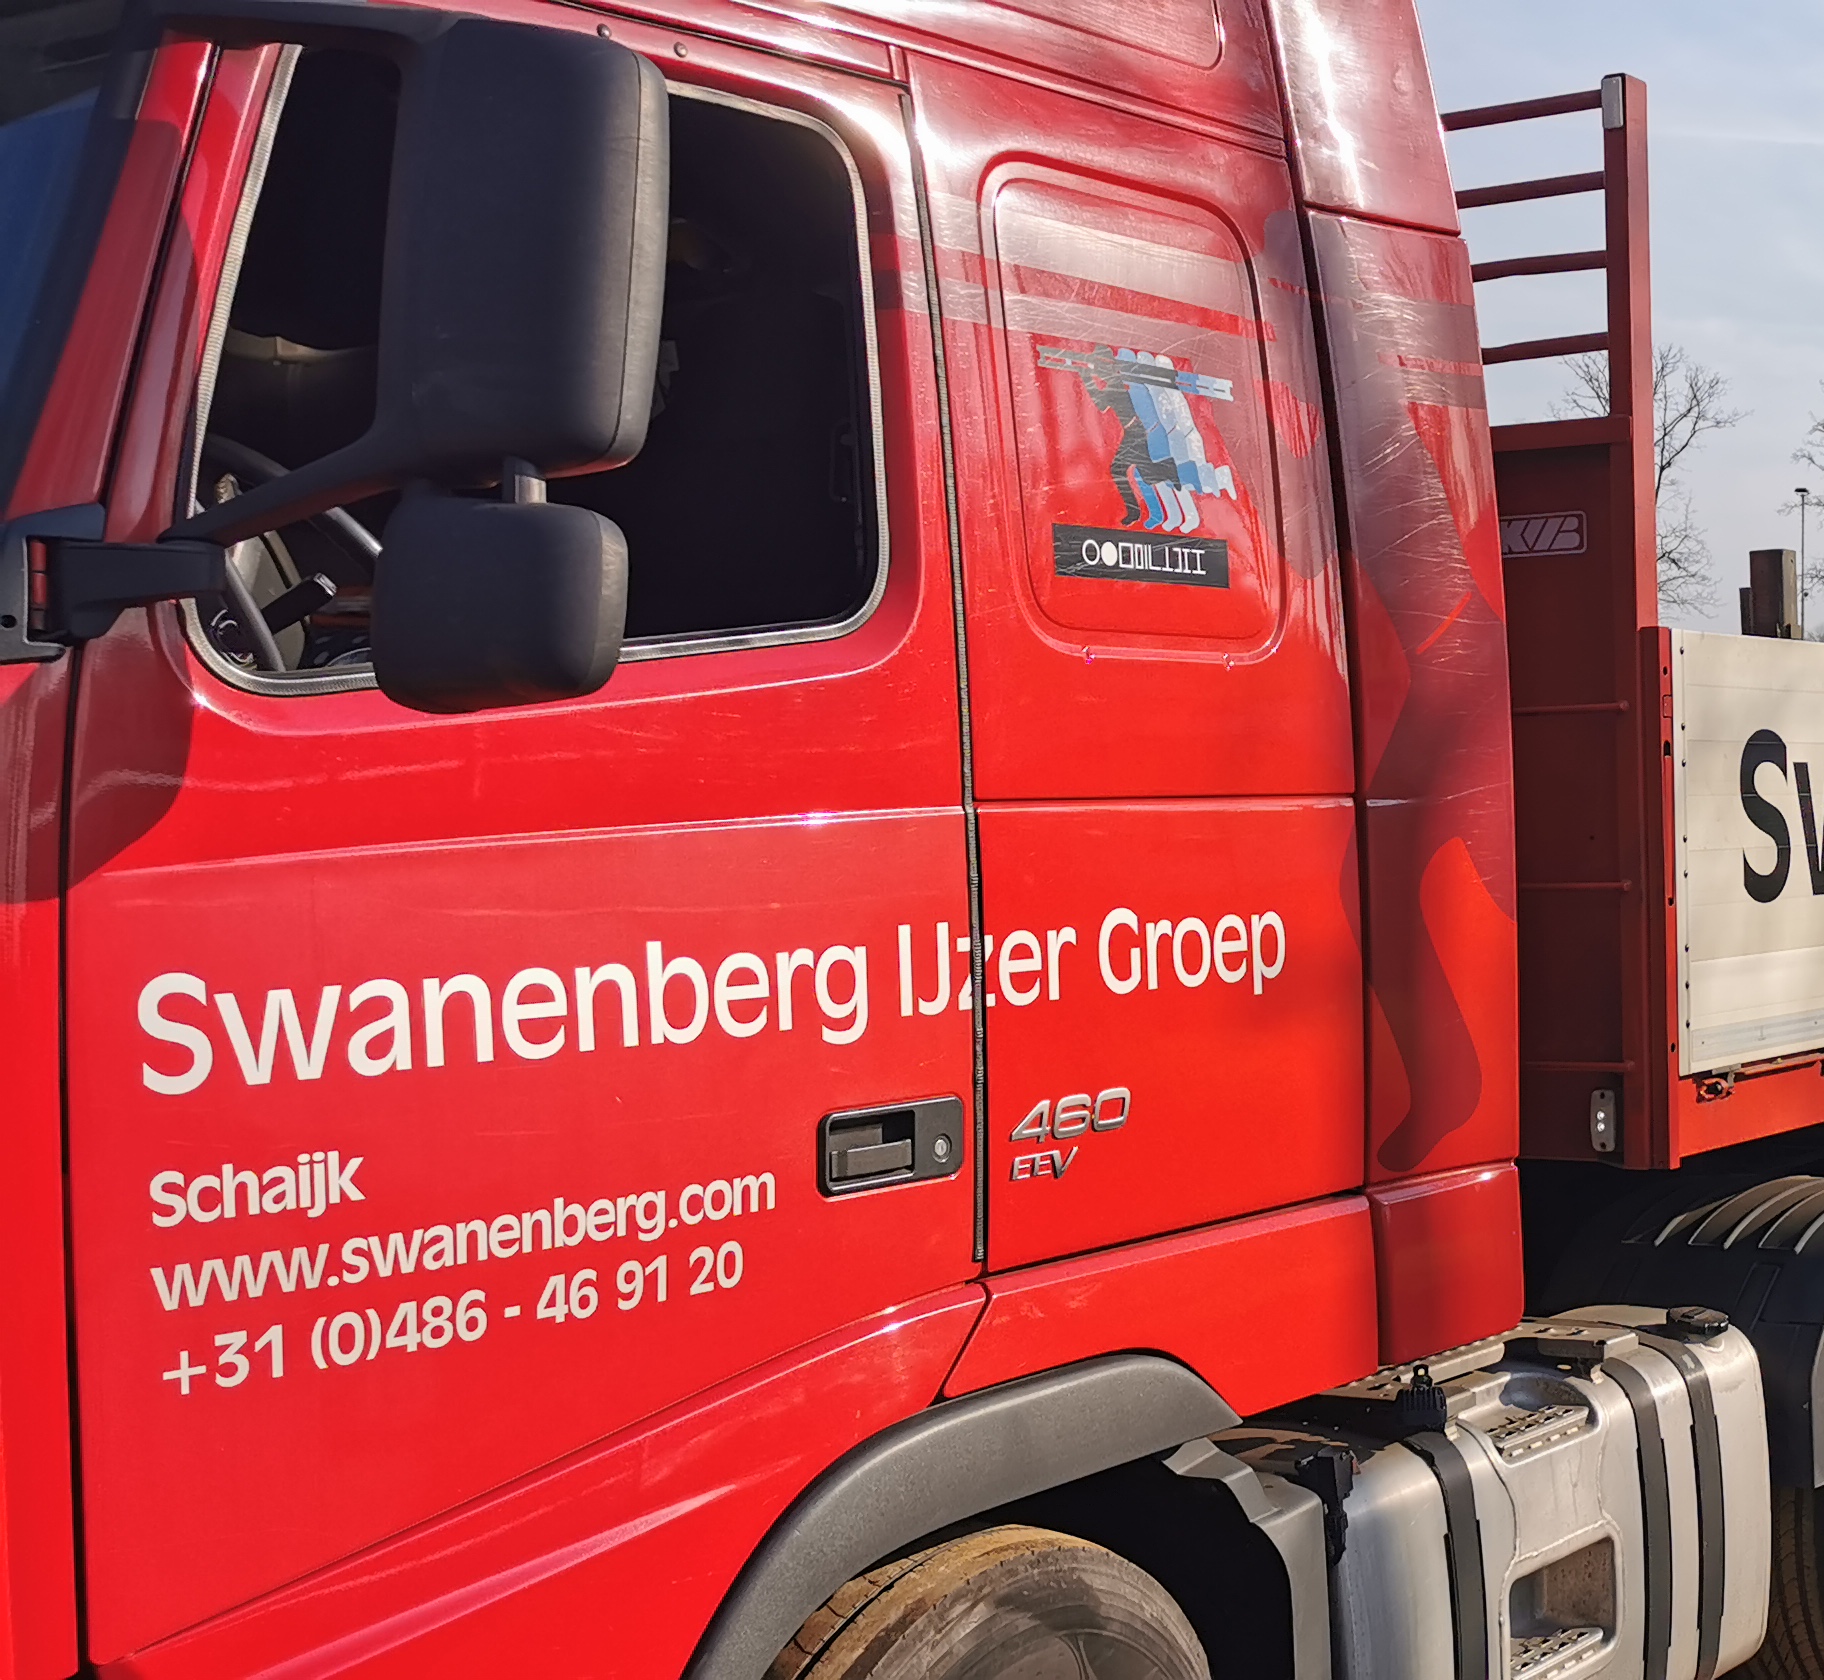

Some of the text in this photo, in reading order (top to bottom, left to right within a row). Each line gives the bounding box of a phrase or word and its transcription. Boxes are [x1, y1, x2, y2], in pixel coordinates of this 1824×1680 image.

[138, 907, 1286, 1095] Swanenberg IJzer Groep
[1010, 1086, 1131, 1143] 460
[1010, 1146, 1079, 1182] EEV
[150, 1151, 365, 1228] Schaijk
[150, 1172, 776, 1311] www.swanenberg.com
[163, 1325, 284, 1395] +31
[312, 1290, 488, 1370] (0)486
[537, 1269, 599, 1324] 46
[617, 1255, 667, 1311] 91
[690, 1241, 744, 1296] 20
